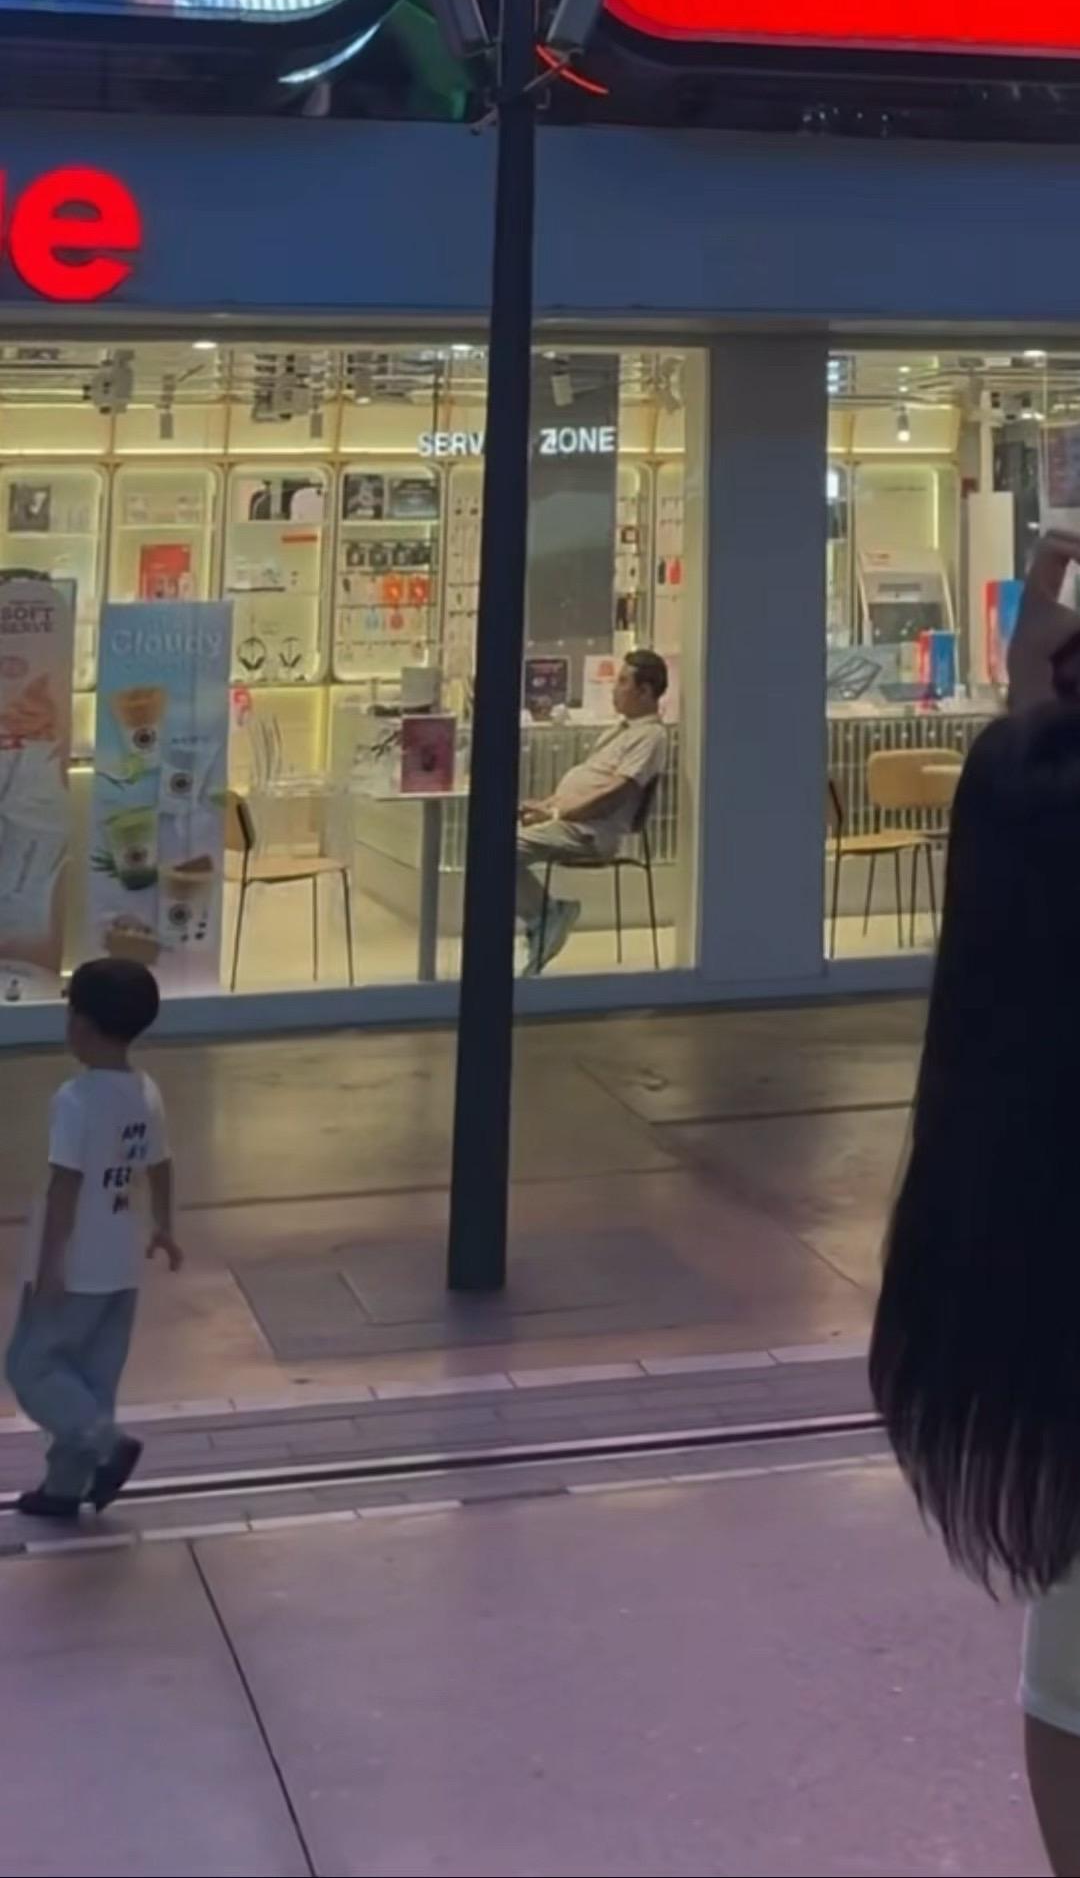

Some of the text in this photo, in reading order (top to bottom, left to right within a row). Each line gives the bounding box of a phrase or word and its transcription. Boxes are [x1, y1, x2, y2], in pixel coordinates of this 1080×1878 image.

[0, 164, 142, 302] e
[416, 425, 617, 457] SERV ZONE
[111, 627, 223, 658] Cloudy
